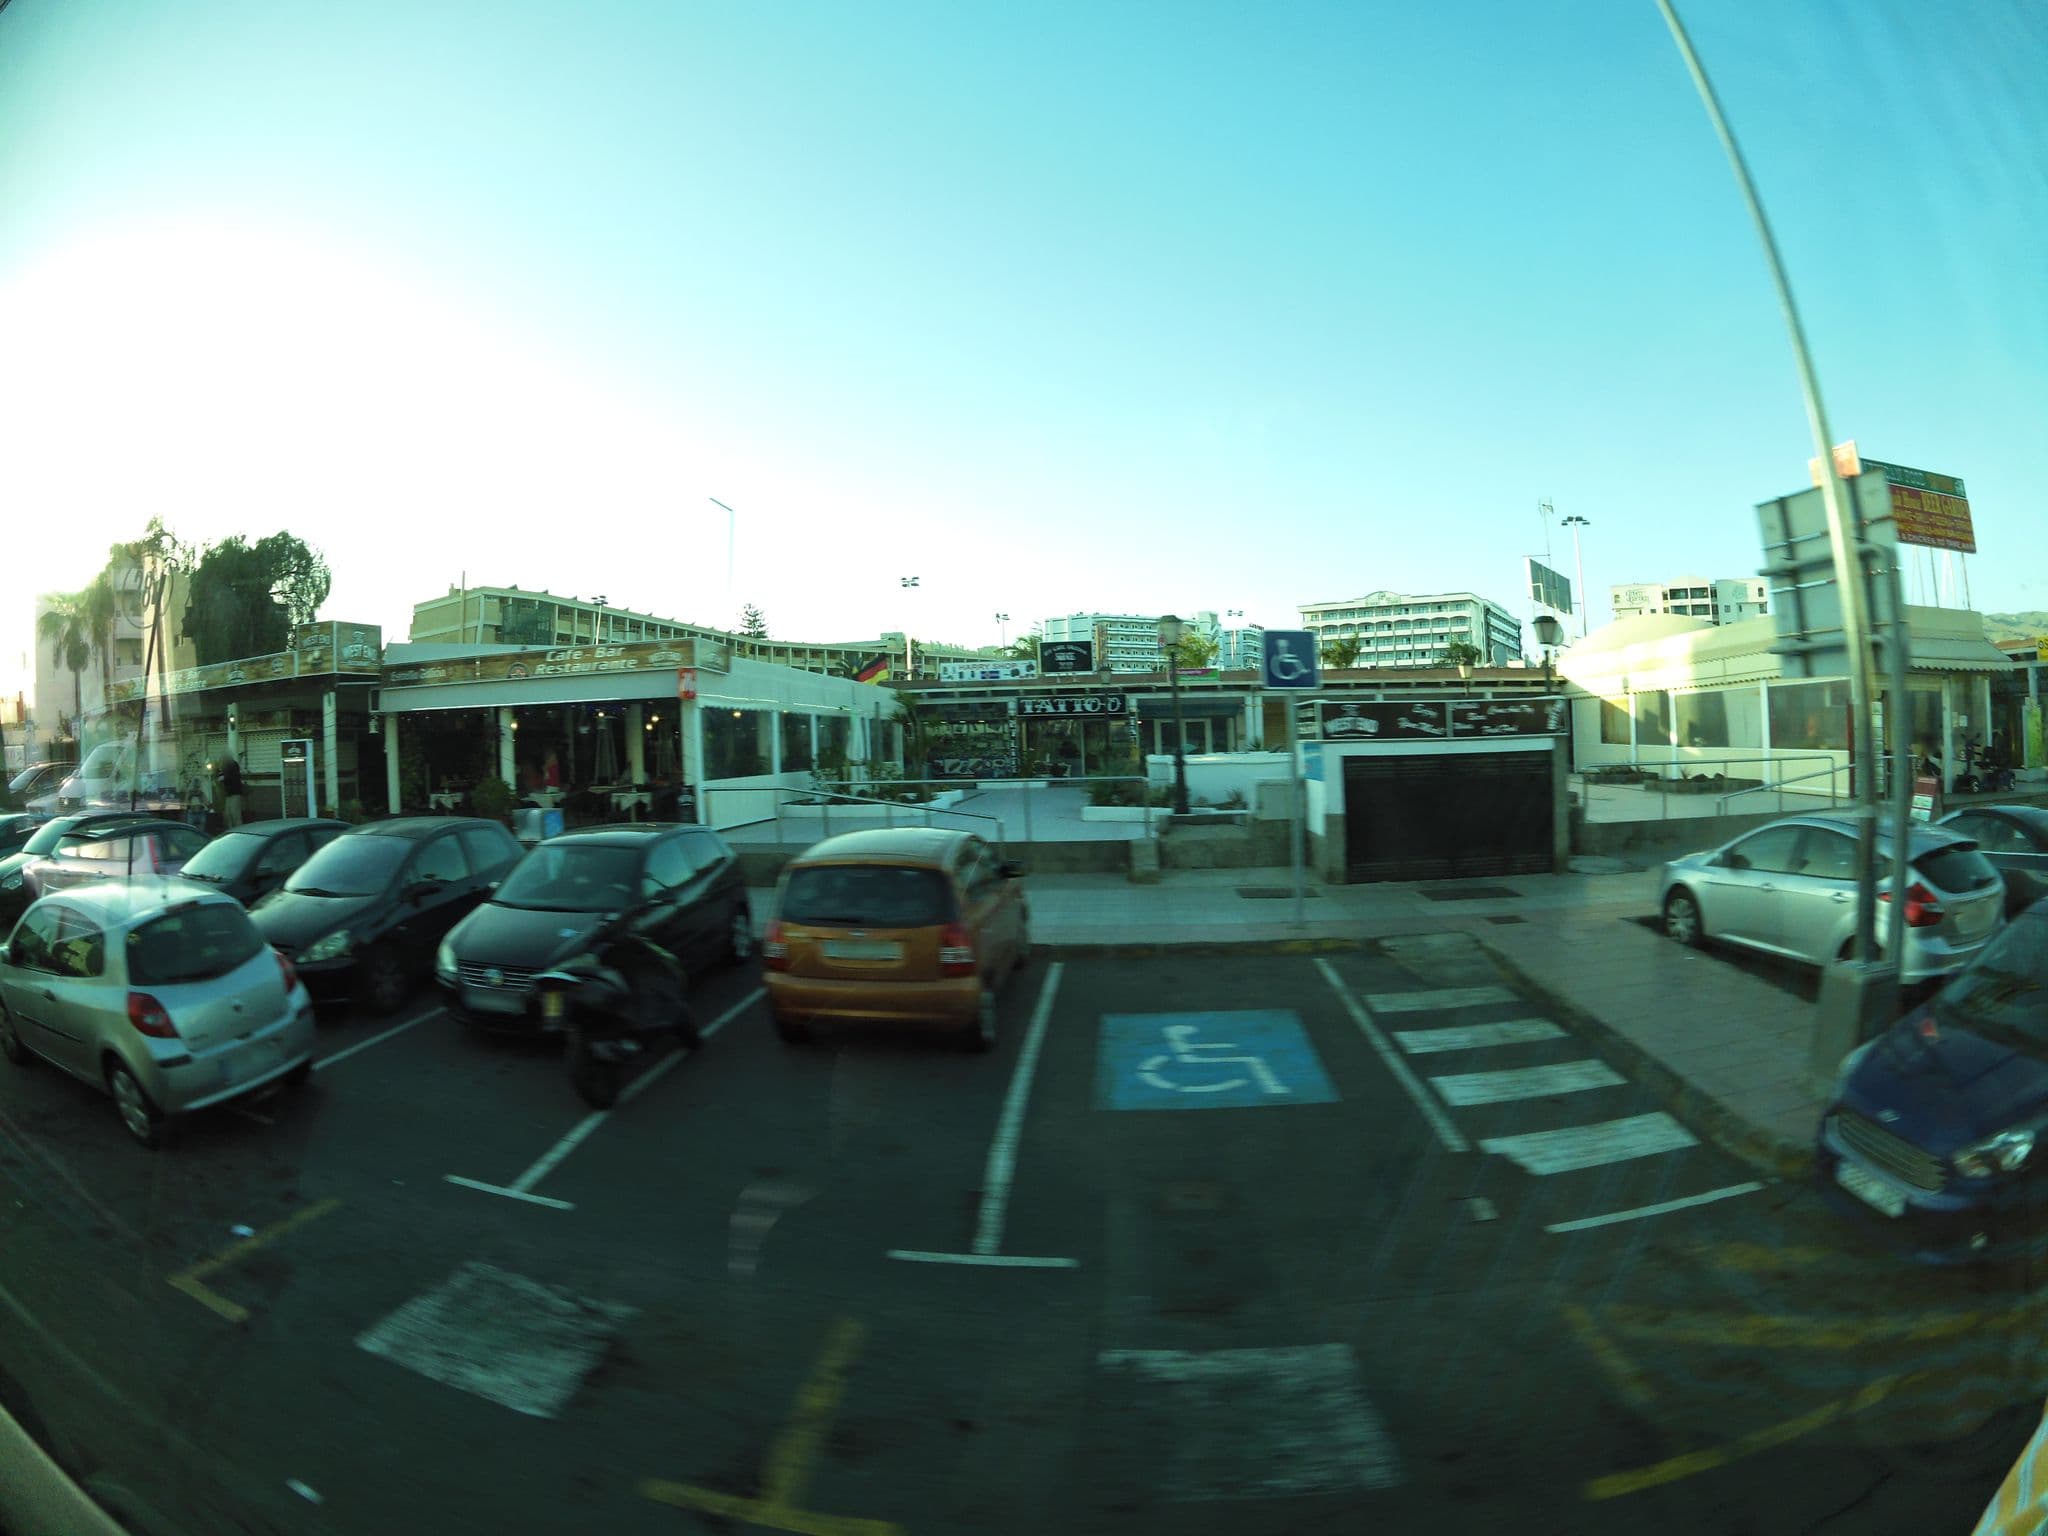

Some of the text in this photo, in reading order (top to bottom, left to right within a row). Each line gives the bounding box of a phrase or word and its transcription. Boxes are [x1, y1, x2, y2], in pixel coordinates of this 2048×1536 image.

[594, 646, 626, 659] Bar
[534, 658, 639, 676] Restaurante
[1020, 697, 1122, 714] TATTOO
